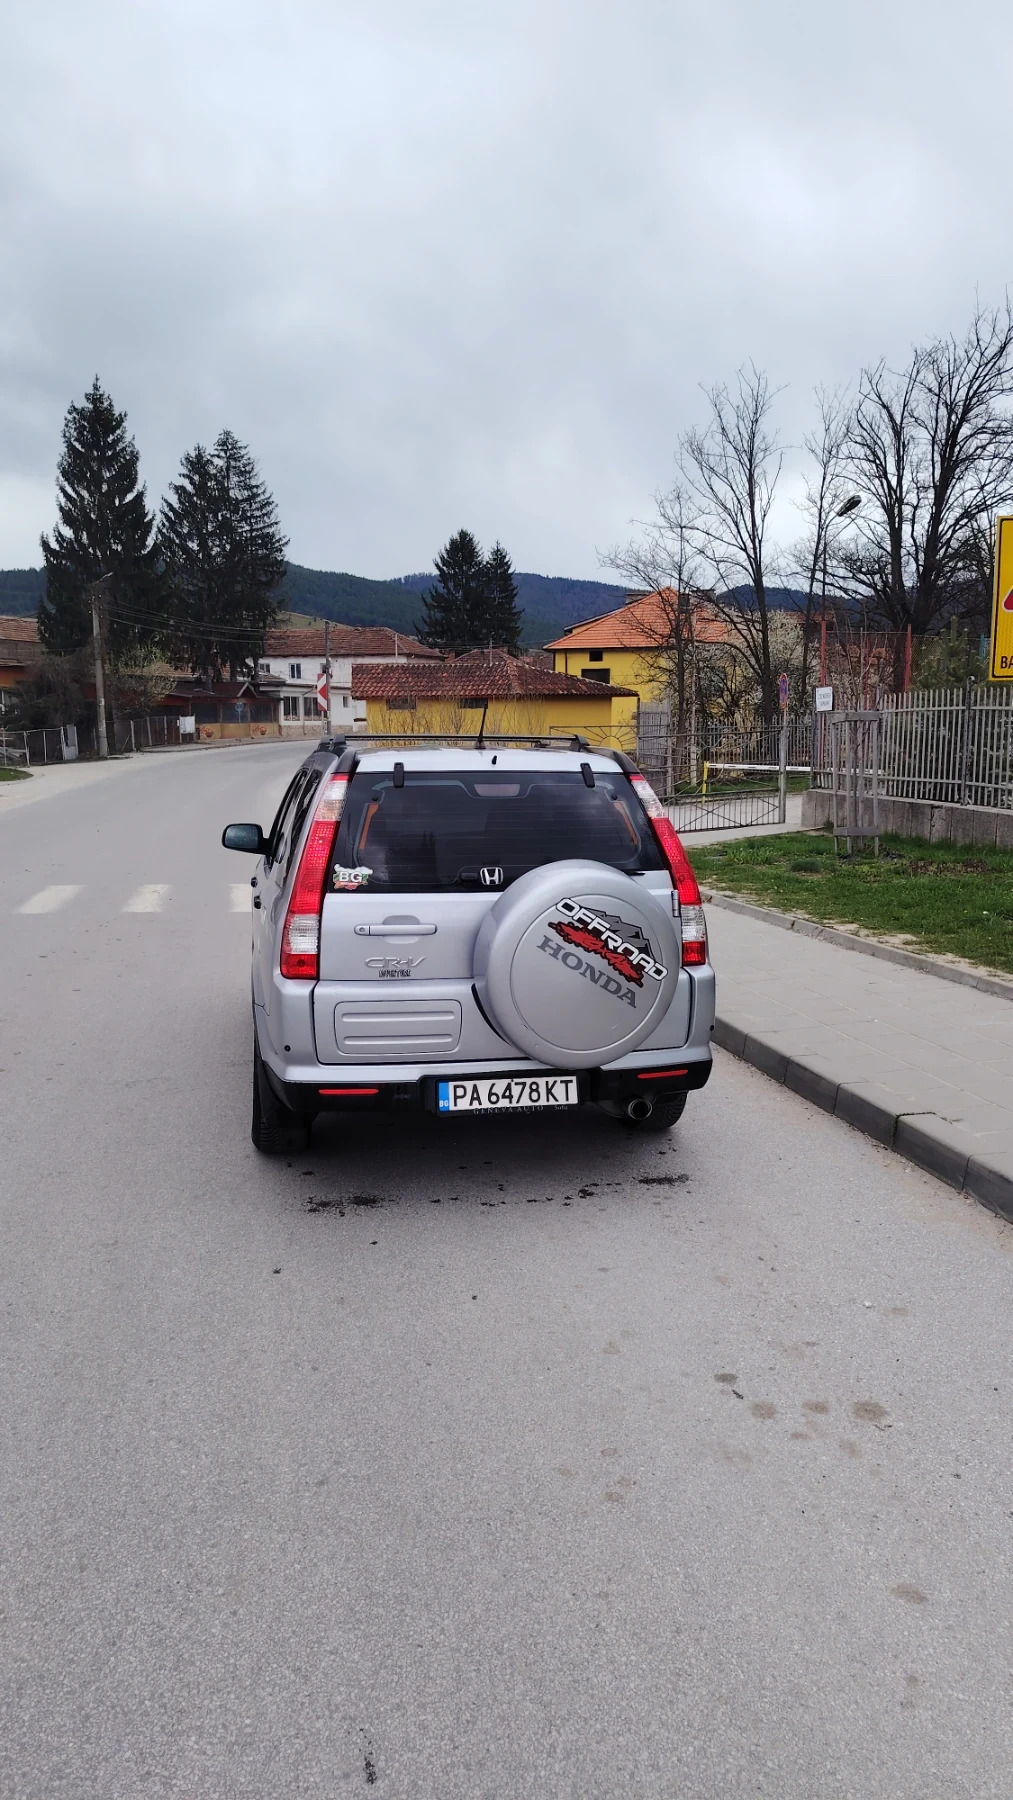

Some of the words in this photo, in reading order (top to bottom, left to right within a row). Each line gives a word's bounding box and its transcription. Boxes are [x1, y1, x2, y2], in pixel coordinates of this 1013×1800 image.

[339, 871, 363, 882] BG
[537, 935, 637, 1009] HONDA
[473, 1106, 513, 1115] GENEVA
[517, 1106, 544, 1114] AUTO
